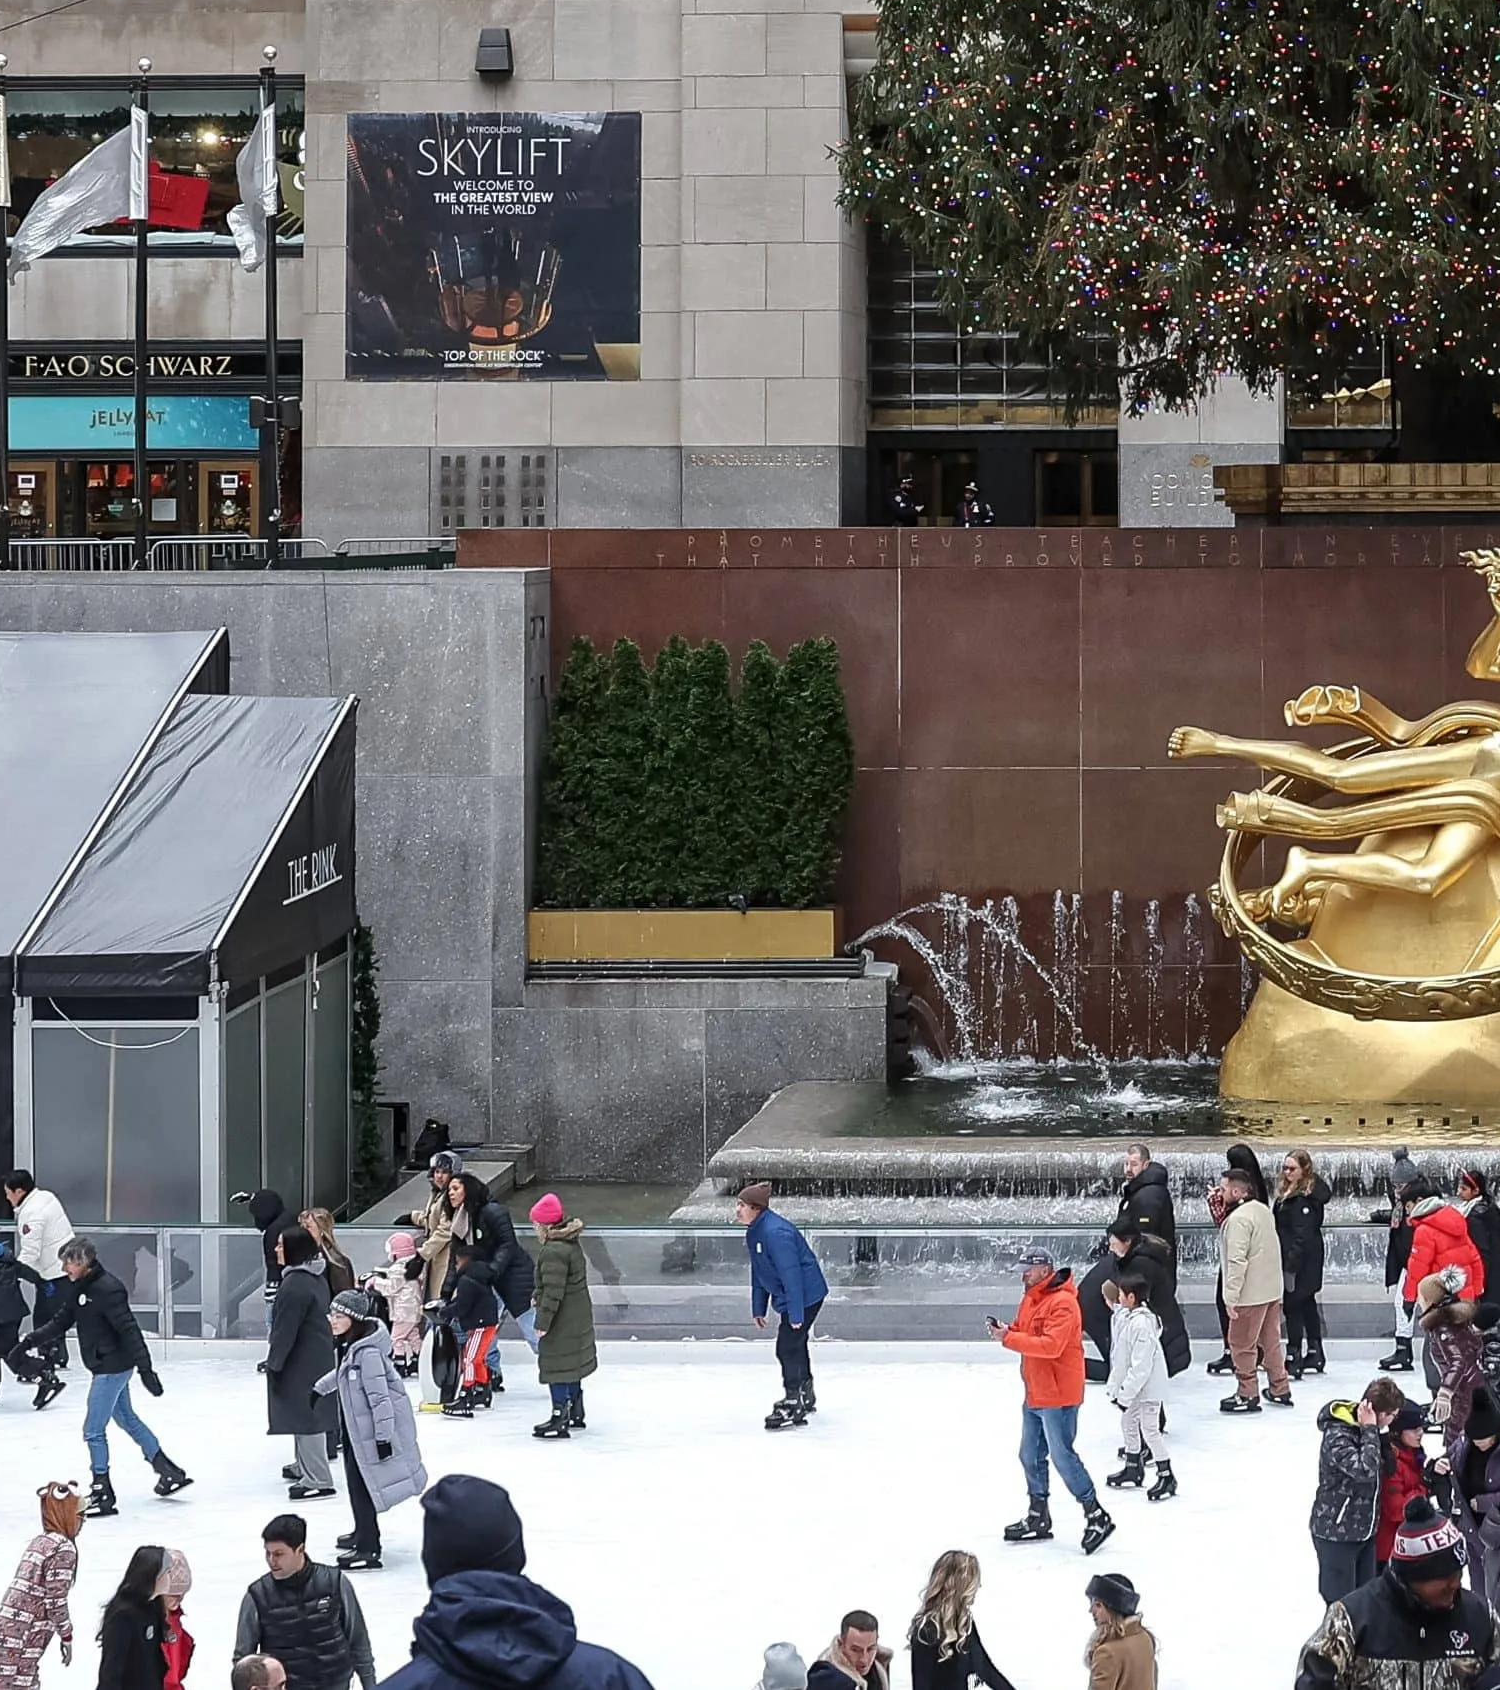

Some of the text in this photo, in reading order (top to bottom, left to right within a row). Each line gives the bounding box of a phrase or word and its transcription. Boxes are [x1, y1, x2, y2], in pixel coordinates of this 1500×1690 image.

[466, 126, 522, 134] INTRODUCING
[416, 138, 572, 176] SKYLIFT
[453, 180, 534, 191] WELCOME TO
[433, 192, 555, 203] THE GREATEST VIEW
[451, 204, 537, 215] IN THE WORLD
[443, 350, 466, 361] TOP
[468, 350, 485, 361] OF
[487, 350, 506, 361] THE
[656, 553, 761, 568] THAT
[814, 553, 920, 568] HATH
[287, 842, 337, 899] THE RINK
